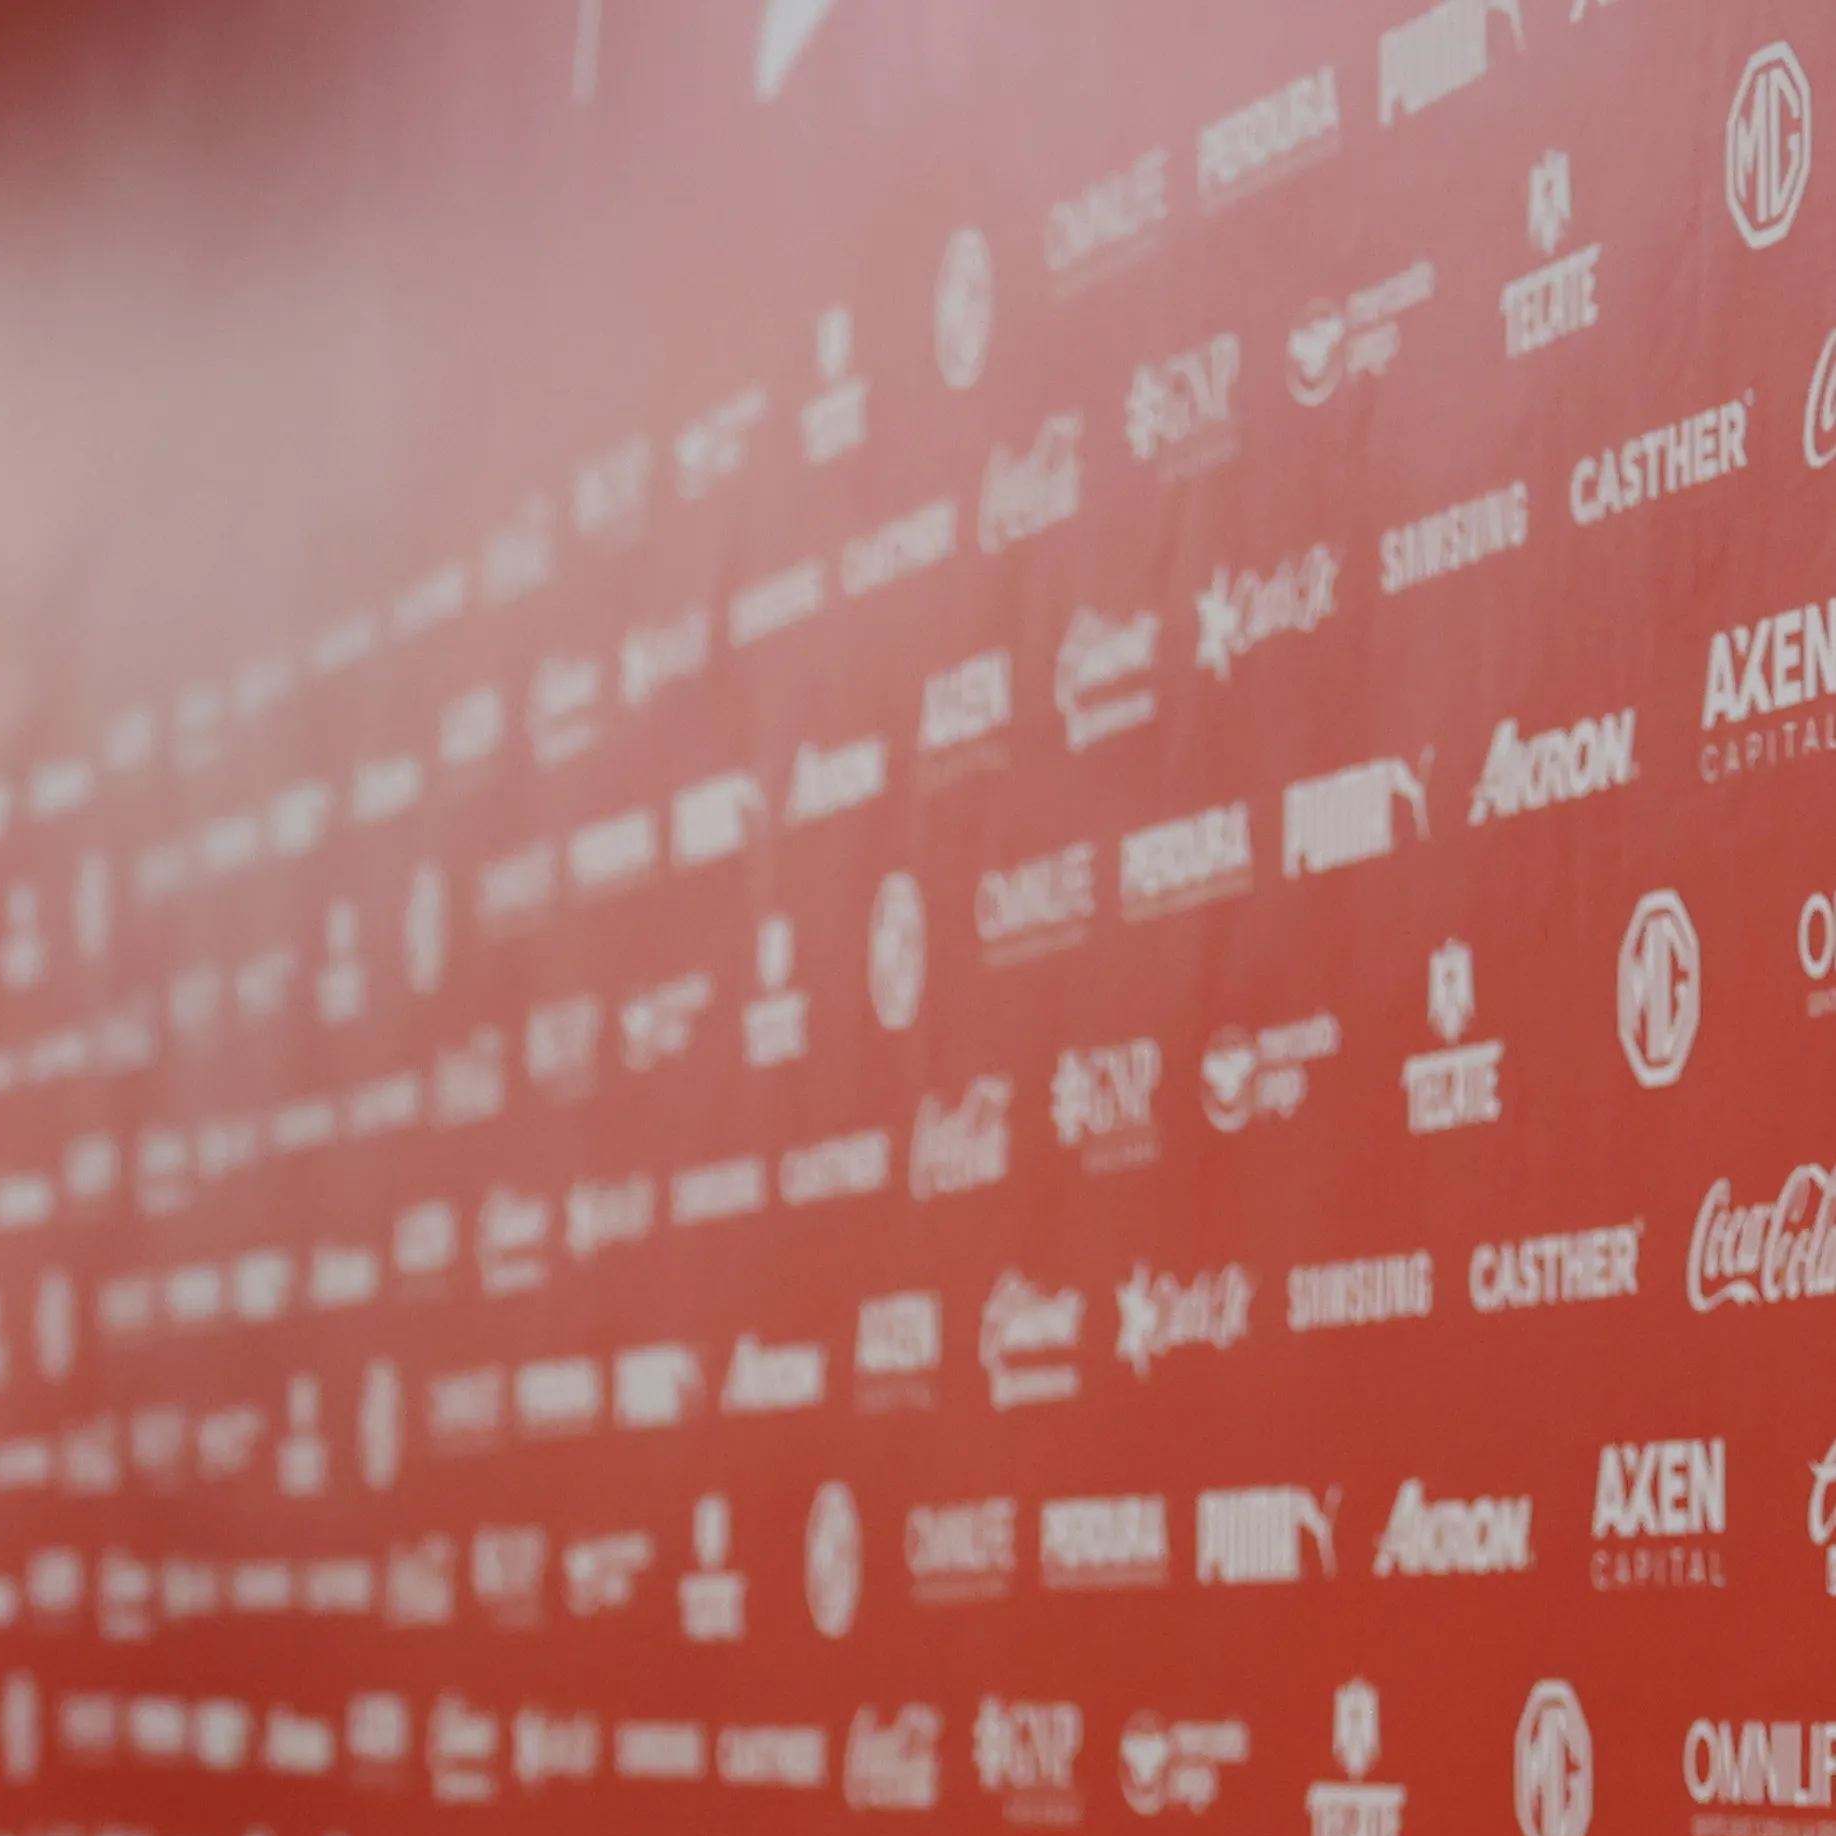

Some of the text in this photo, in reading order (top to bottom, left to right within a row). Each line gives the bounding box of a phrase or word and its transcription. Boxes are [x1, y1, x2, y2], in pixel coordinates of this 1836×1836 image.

[1732, 54, 1808, 236] MG
[1570, 399, 1747, 525] CASTHER
[1704, 598, 1836, 728] AXEN
[1470, 1223, 1642, 1310] CASTHER
[1593, 1439, 1724, 1537] AXEN
